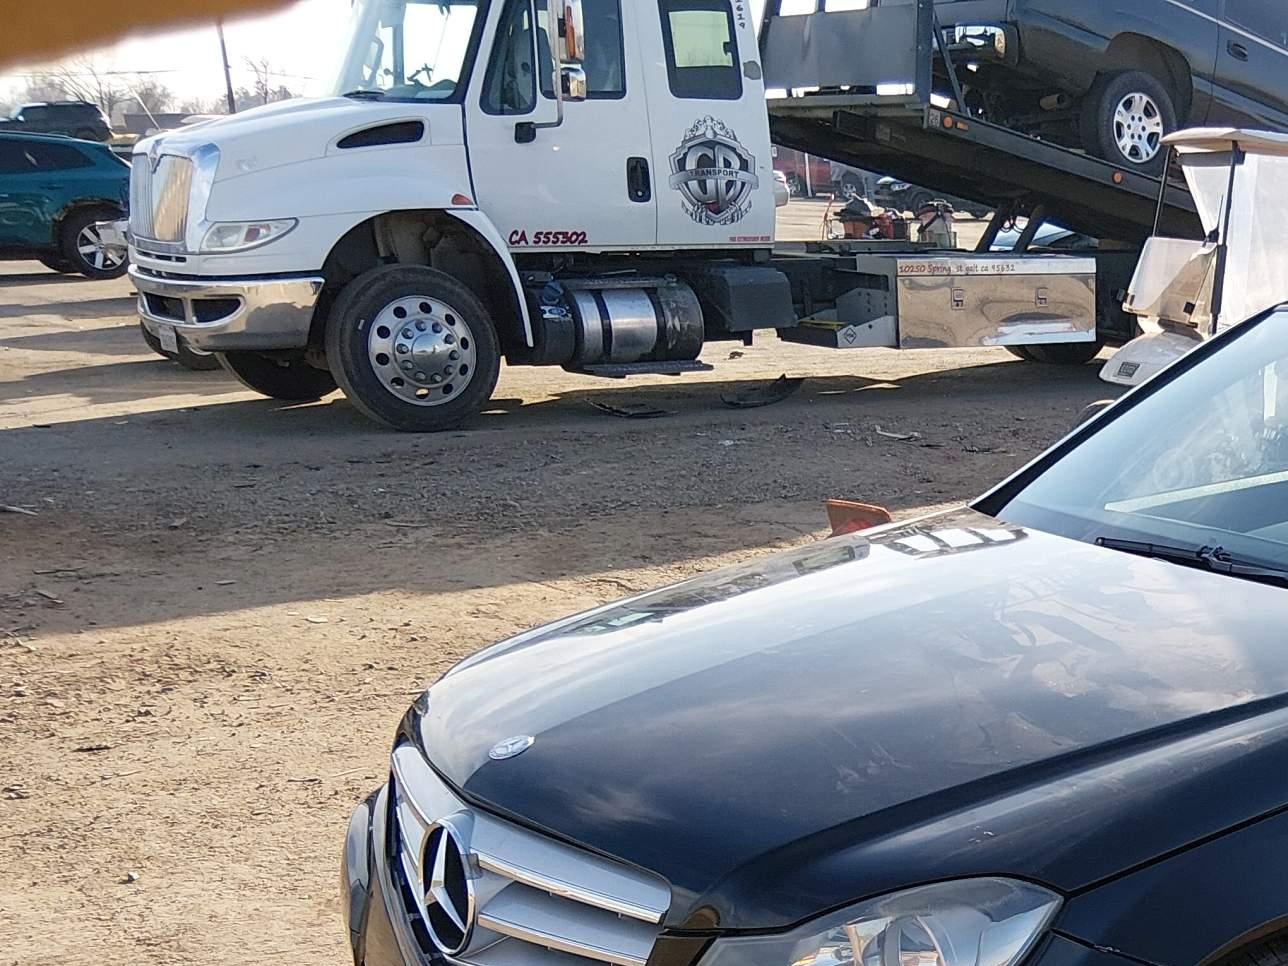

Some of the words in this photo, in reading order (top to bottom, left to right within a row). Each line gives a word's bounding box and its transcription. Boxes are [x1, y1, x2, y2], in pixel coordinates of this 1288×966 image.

[689, 168, 740, 179] TRANSPORT
[508, 229, 529, 245] CA
[532, 230, 589, 246] 555302
[899, 264, 926, 273] 10250
[927, 263, 952, 276] Spring
[956, 263, 964, 272] st
[965, 264, 979, 275] galt
[991, 263, 1016, 273] 95632
